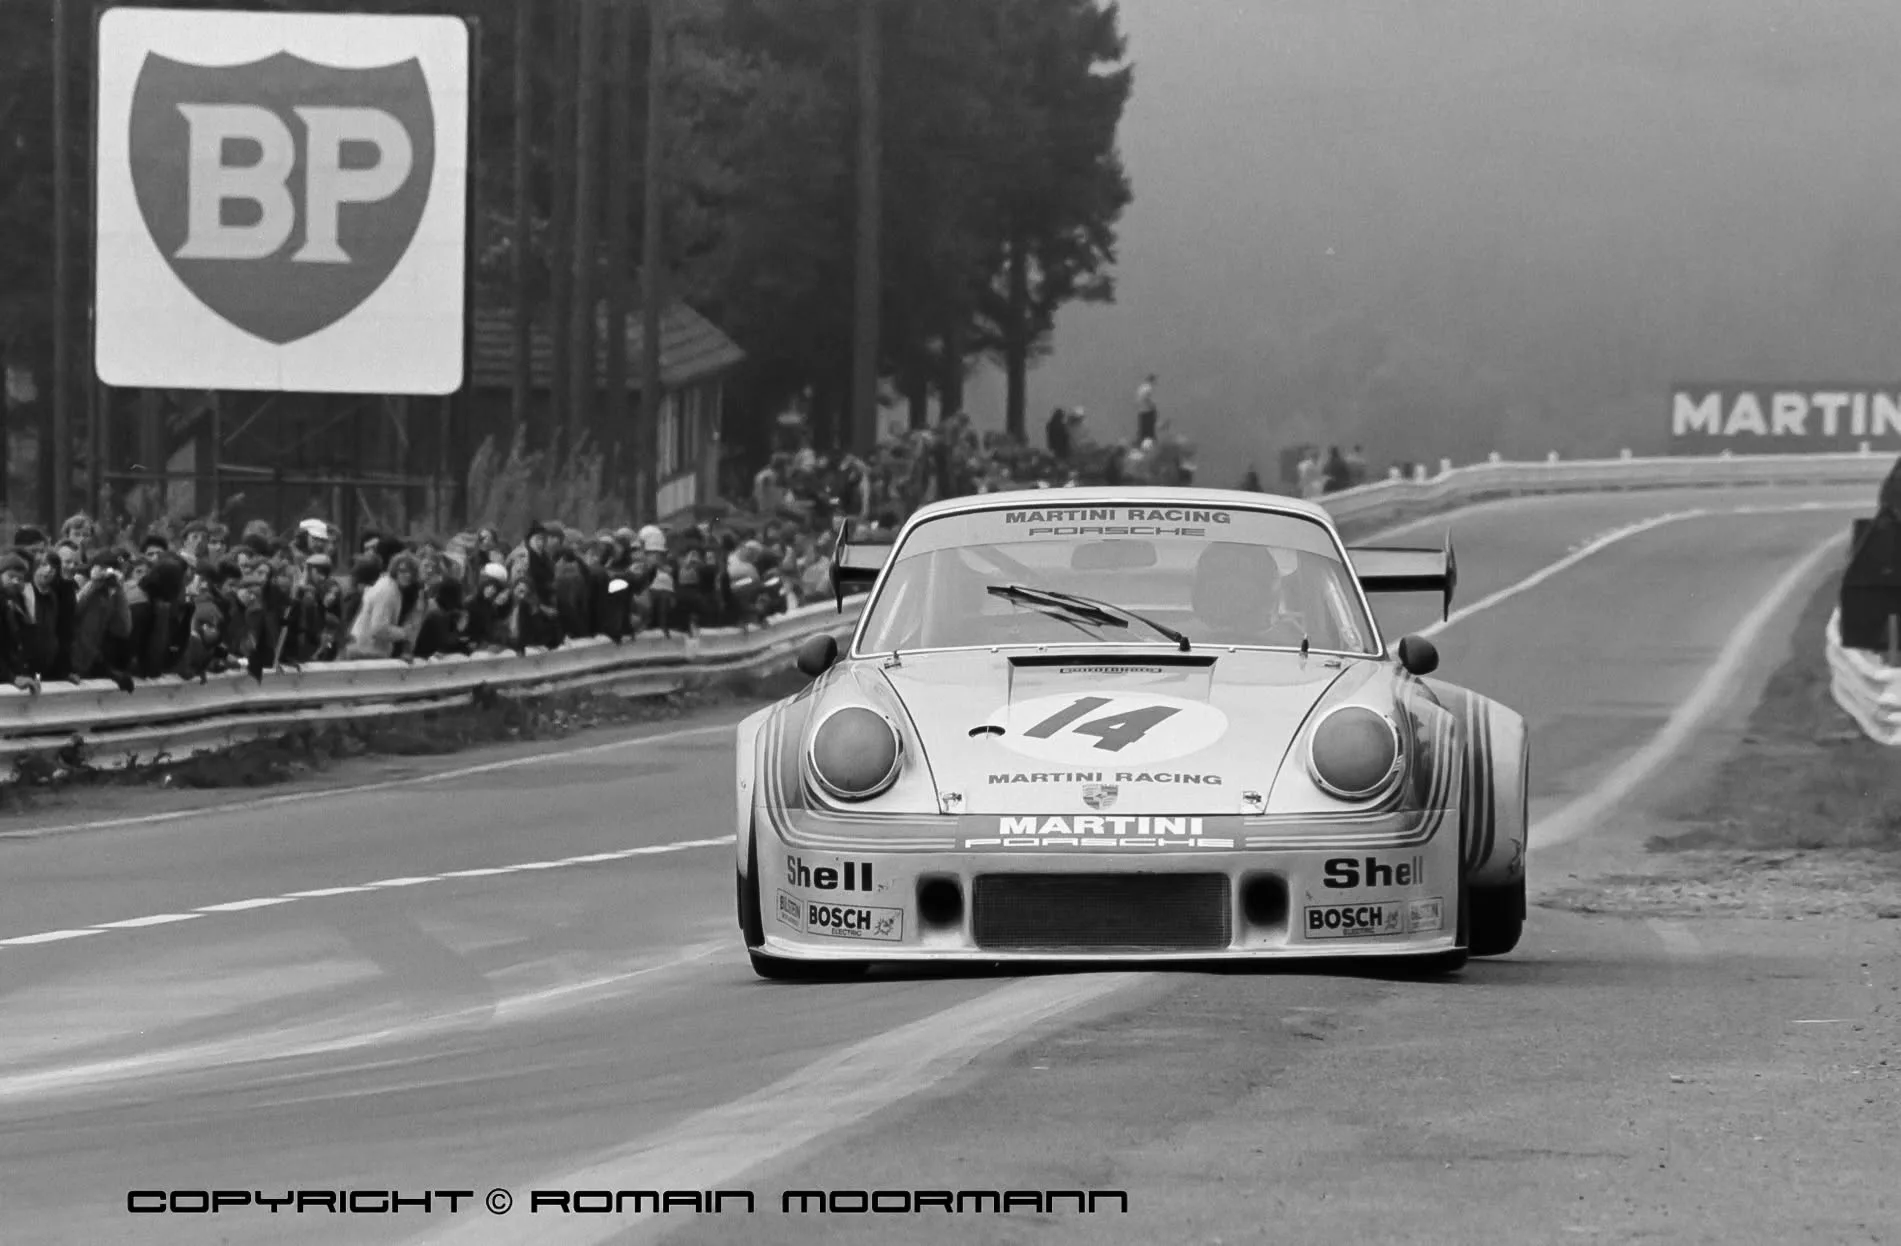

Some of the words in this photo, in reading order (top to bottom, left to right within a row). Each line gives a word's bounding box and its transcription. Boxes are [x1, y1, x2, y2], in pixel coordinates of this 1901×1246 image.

[174, 103, 413, 264] BP
[1672, 390, 1901, 436] MARTIN
[1005, 509, 1116, 524] MARTINI
[1128, 509, 1231, 524] RACING
[1029, 527, 1205, 537] PORSCHE
[1023, 696, 1183, 752] 14
[988, 772, 1103, 785] MARTINI
[1115, 772, 1223, 786] RACING
[1000, 816, 1203, 835] MARTINI
[965, 837, 1234, 848] PORSCHE
[787, 855, 872, 891] Shell
[1323, 856, 1423, 889] Shell
[809, 905, 871, 930] BOSCH
[1309, 906, 1382, 929] BOSCH
